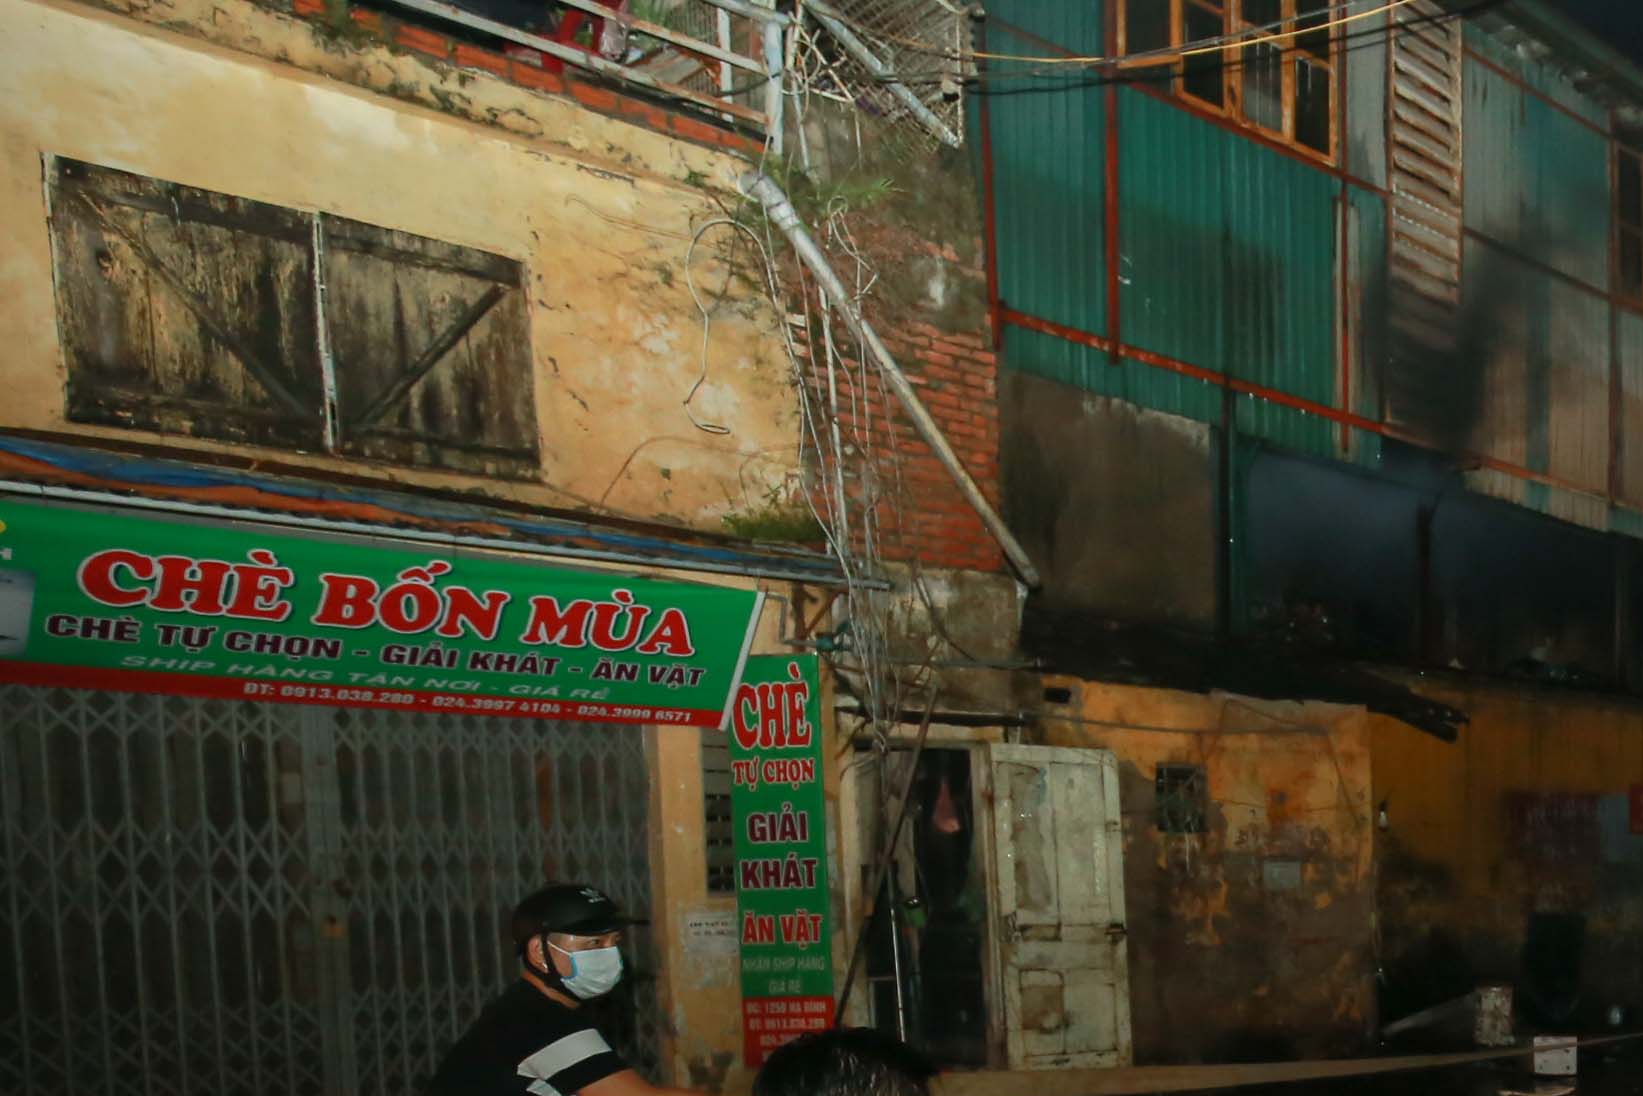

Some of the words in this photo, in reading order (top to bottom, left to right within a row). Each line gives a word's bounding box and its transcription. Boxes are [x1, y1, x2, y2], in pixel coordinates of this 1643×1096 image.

[77, 549, 294, 622] CHÈ
[311, 560, 512, 641] BỐN
[519, 588, 696, 658] MÙA
[46, 614, 142, 643] CHÈ
[155, 624, 218, 653] TỰ
[225, 630, 343, 660] CHỌN
[380, 641, 458, 670] GIẢI
[467, 649, 561, 677] KHÁT
[591, 657, 639, 683] ĂN
[648, 663, 706, 690] VẬT
[121, 655, 215, 670] SHIP
[732, 661, 812, 750] CHÈ
[731, 757, 759, 791] TỰ
[762, 758, 815, 790] CHỌN
[747, 802, 808, 845] GIẢI
[740, 853, 818, 890] KHÁT
[742, 909, 775, 945] ĂN
[780, 908, 823, 949] VẬT
